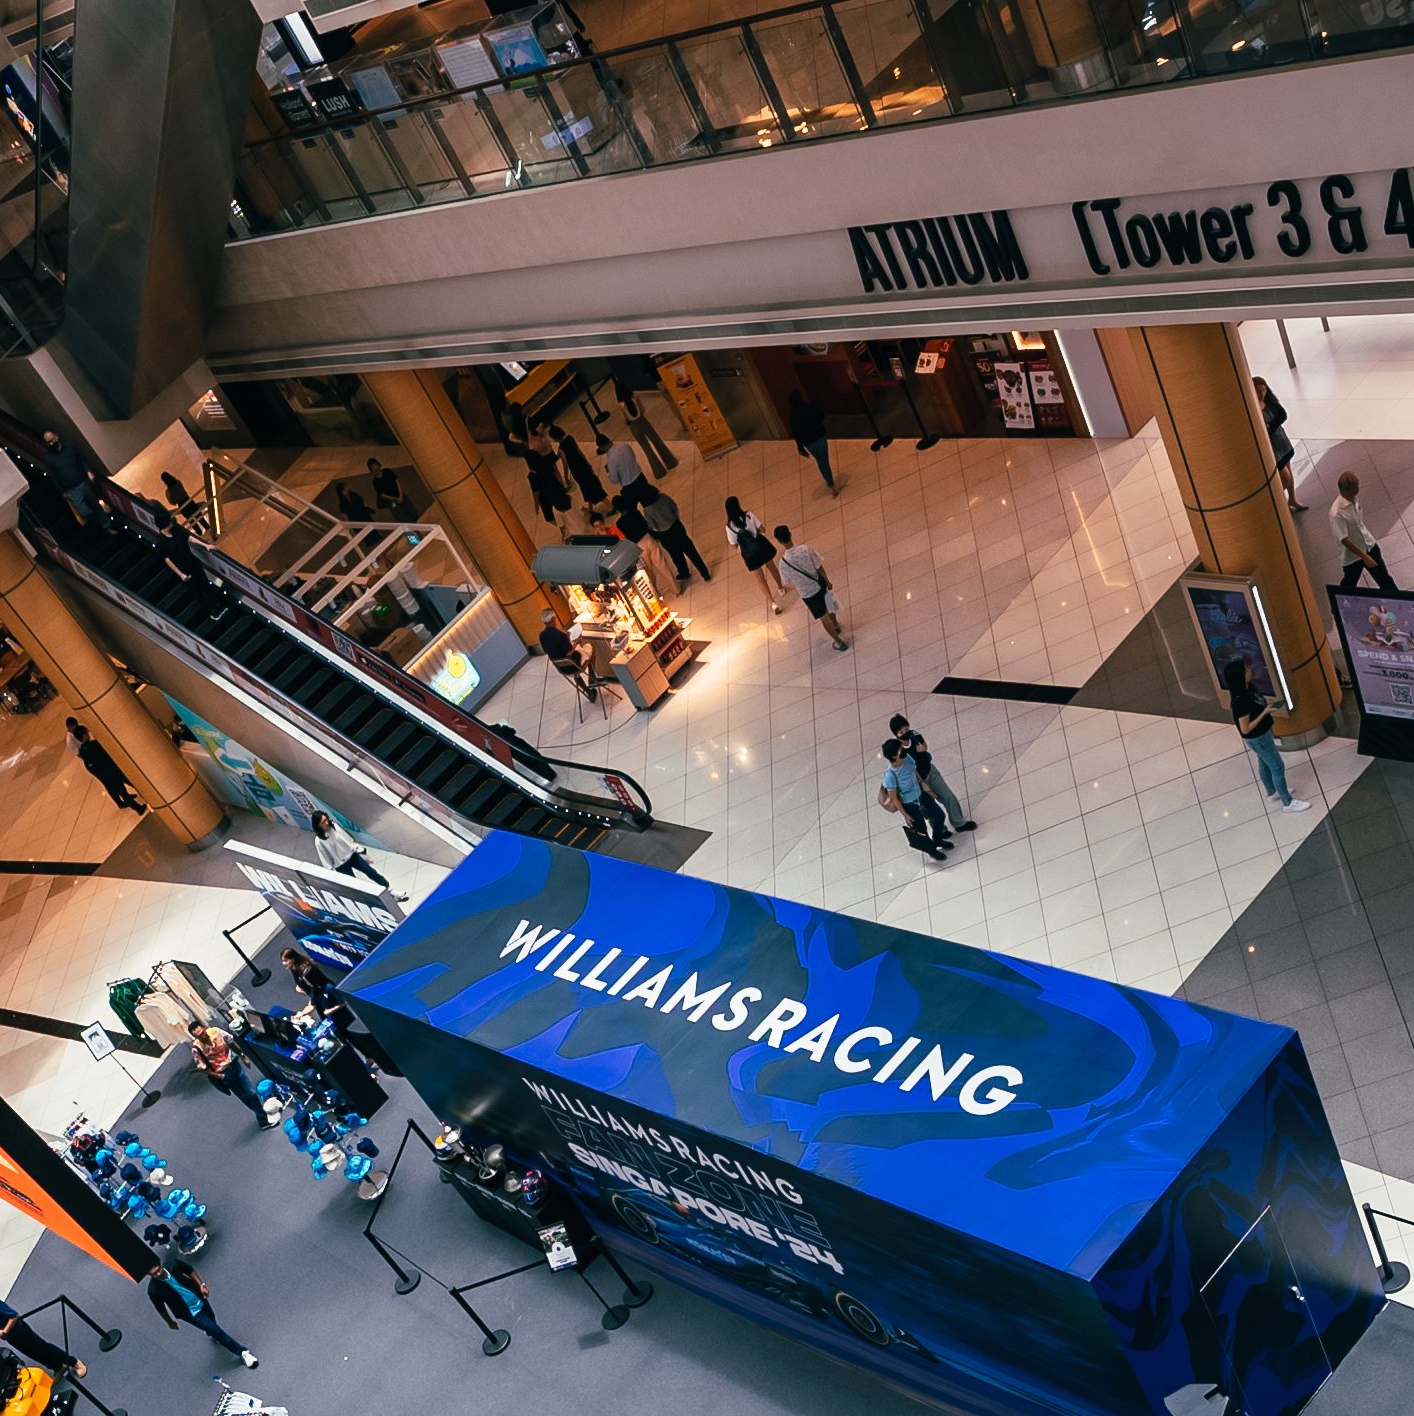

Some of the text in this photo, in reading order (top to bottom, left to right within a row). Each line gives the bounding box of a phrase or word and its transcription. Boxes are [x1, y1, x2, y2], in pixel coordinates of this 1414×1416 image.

[320, 94, 350, 113] LUSH
[847, 208, 1030, 294] ATRIUM
[1071, 197, 1254, 276] (Tower
[1267, 179, 1312, 258] 3
[1319, 173, 1369, 255] &
[1357, 650, 1389, 662] SPEND
[236, 861, 399, 932] WILLIAMS
[541, 1104, 833, 1250] FAN ZONE
[567, 1140, 781, 1244] SINGAPORE
